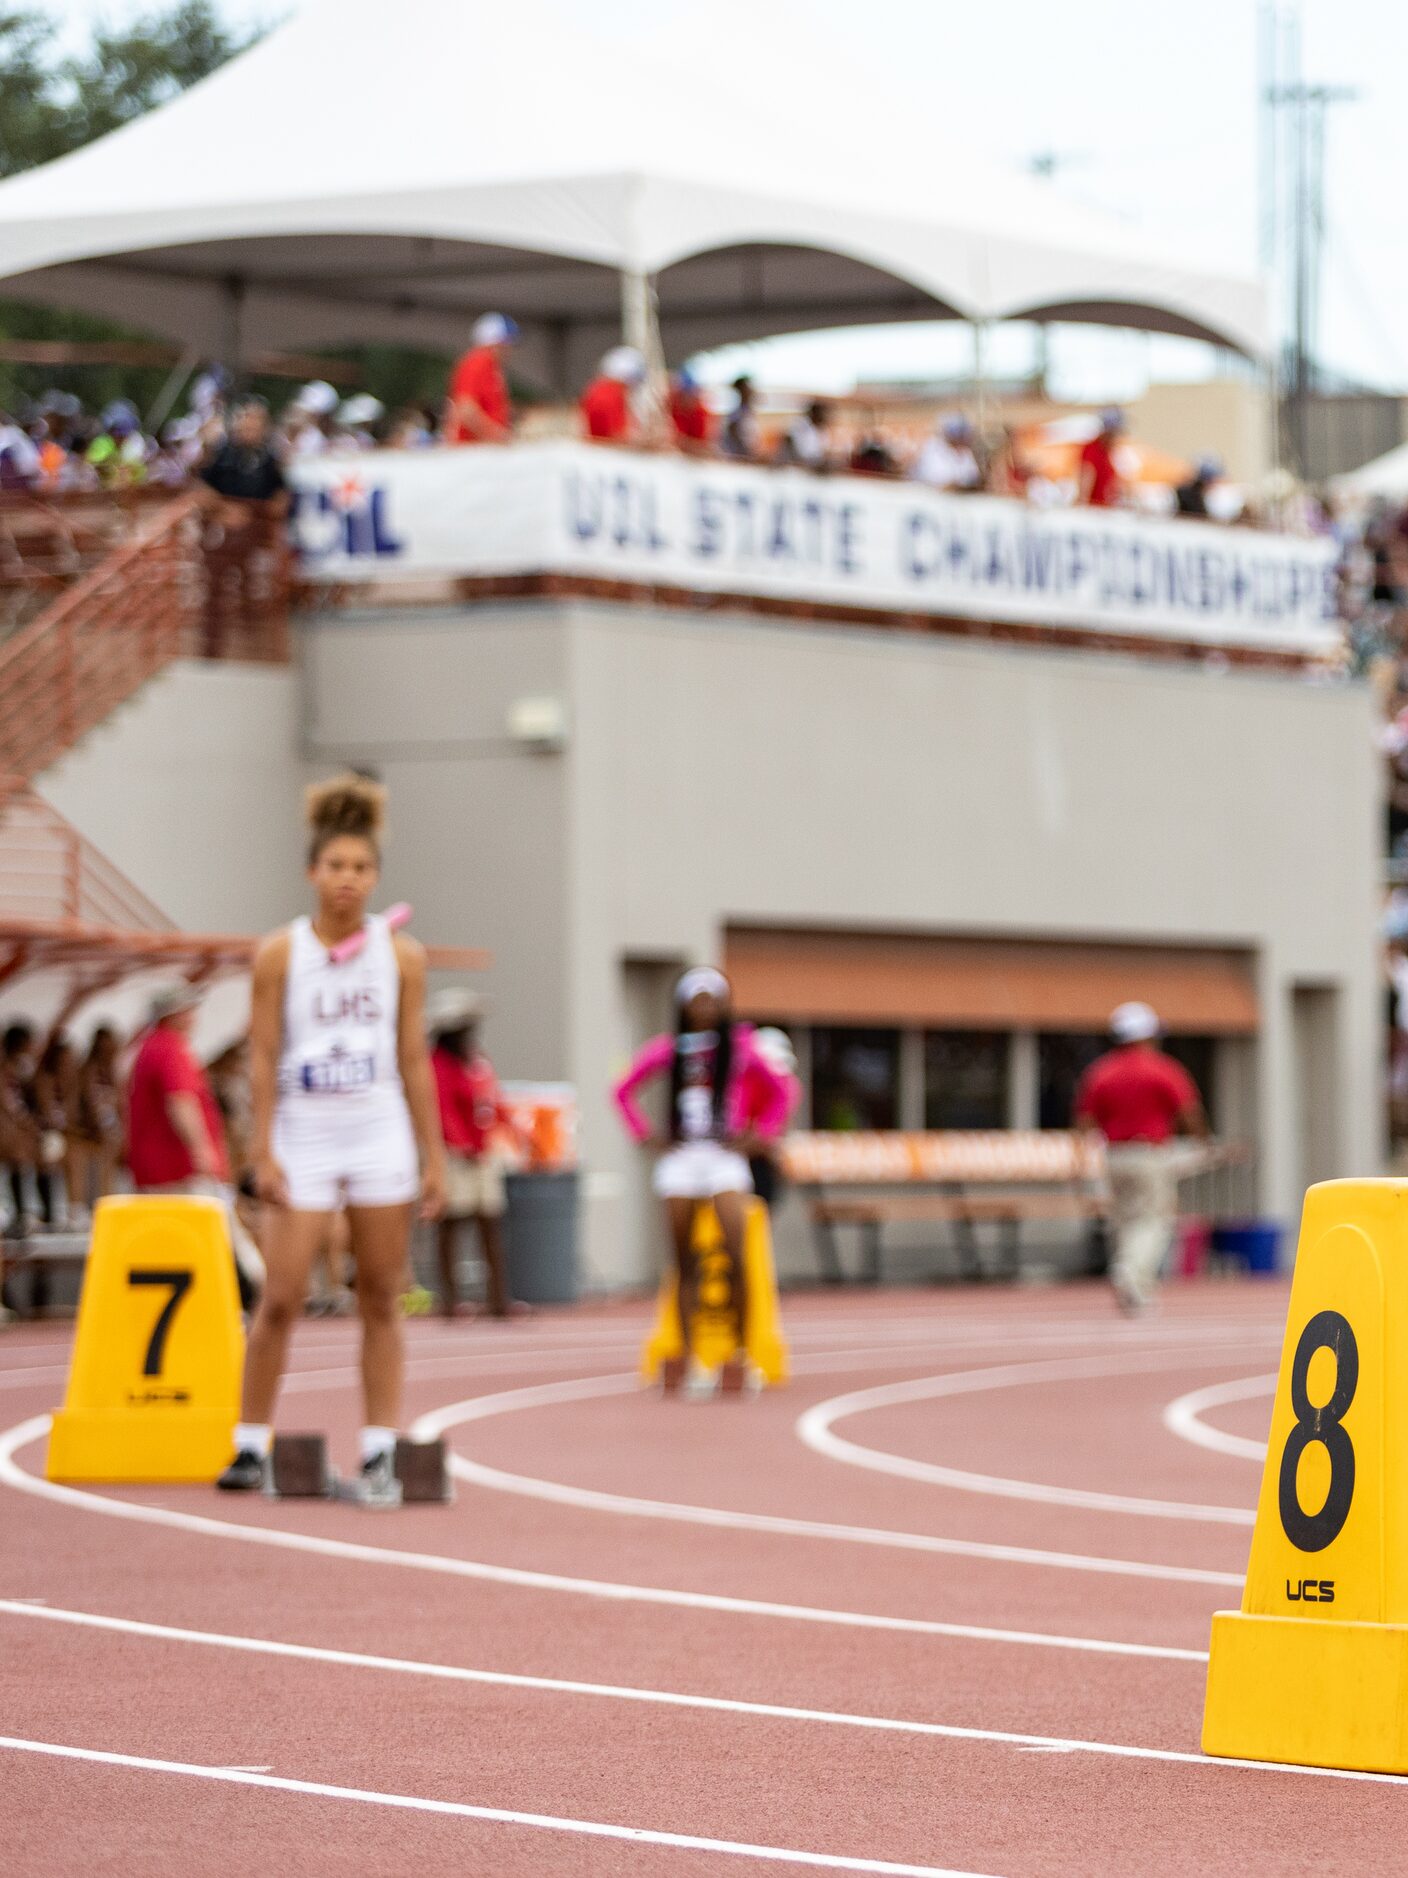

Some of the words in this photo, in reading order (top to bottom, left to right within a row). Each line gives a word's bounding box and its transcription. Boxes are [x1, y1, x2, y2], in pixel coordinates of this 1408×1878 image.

[695, 488, 868, 576] STATE
[127, 1269, 193, 1376] 7
[1278, 1310, 1359, 1553] 8
[1286, 1579, 1335, 1602] UCS
